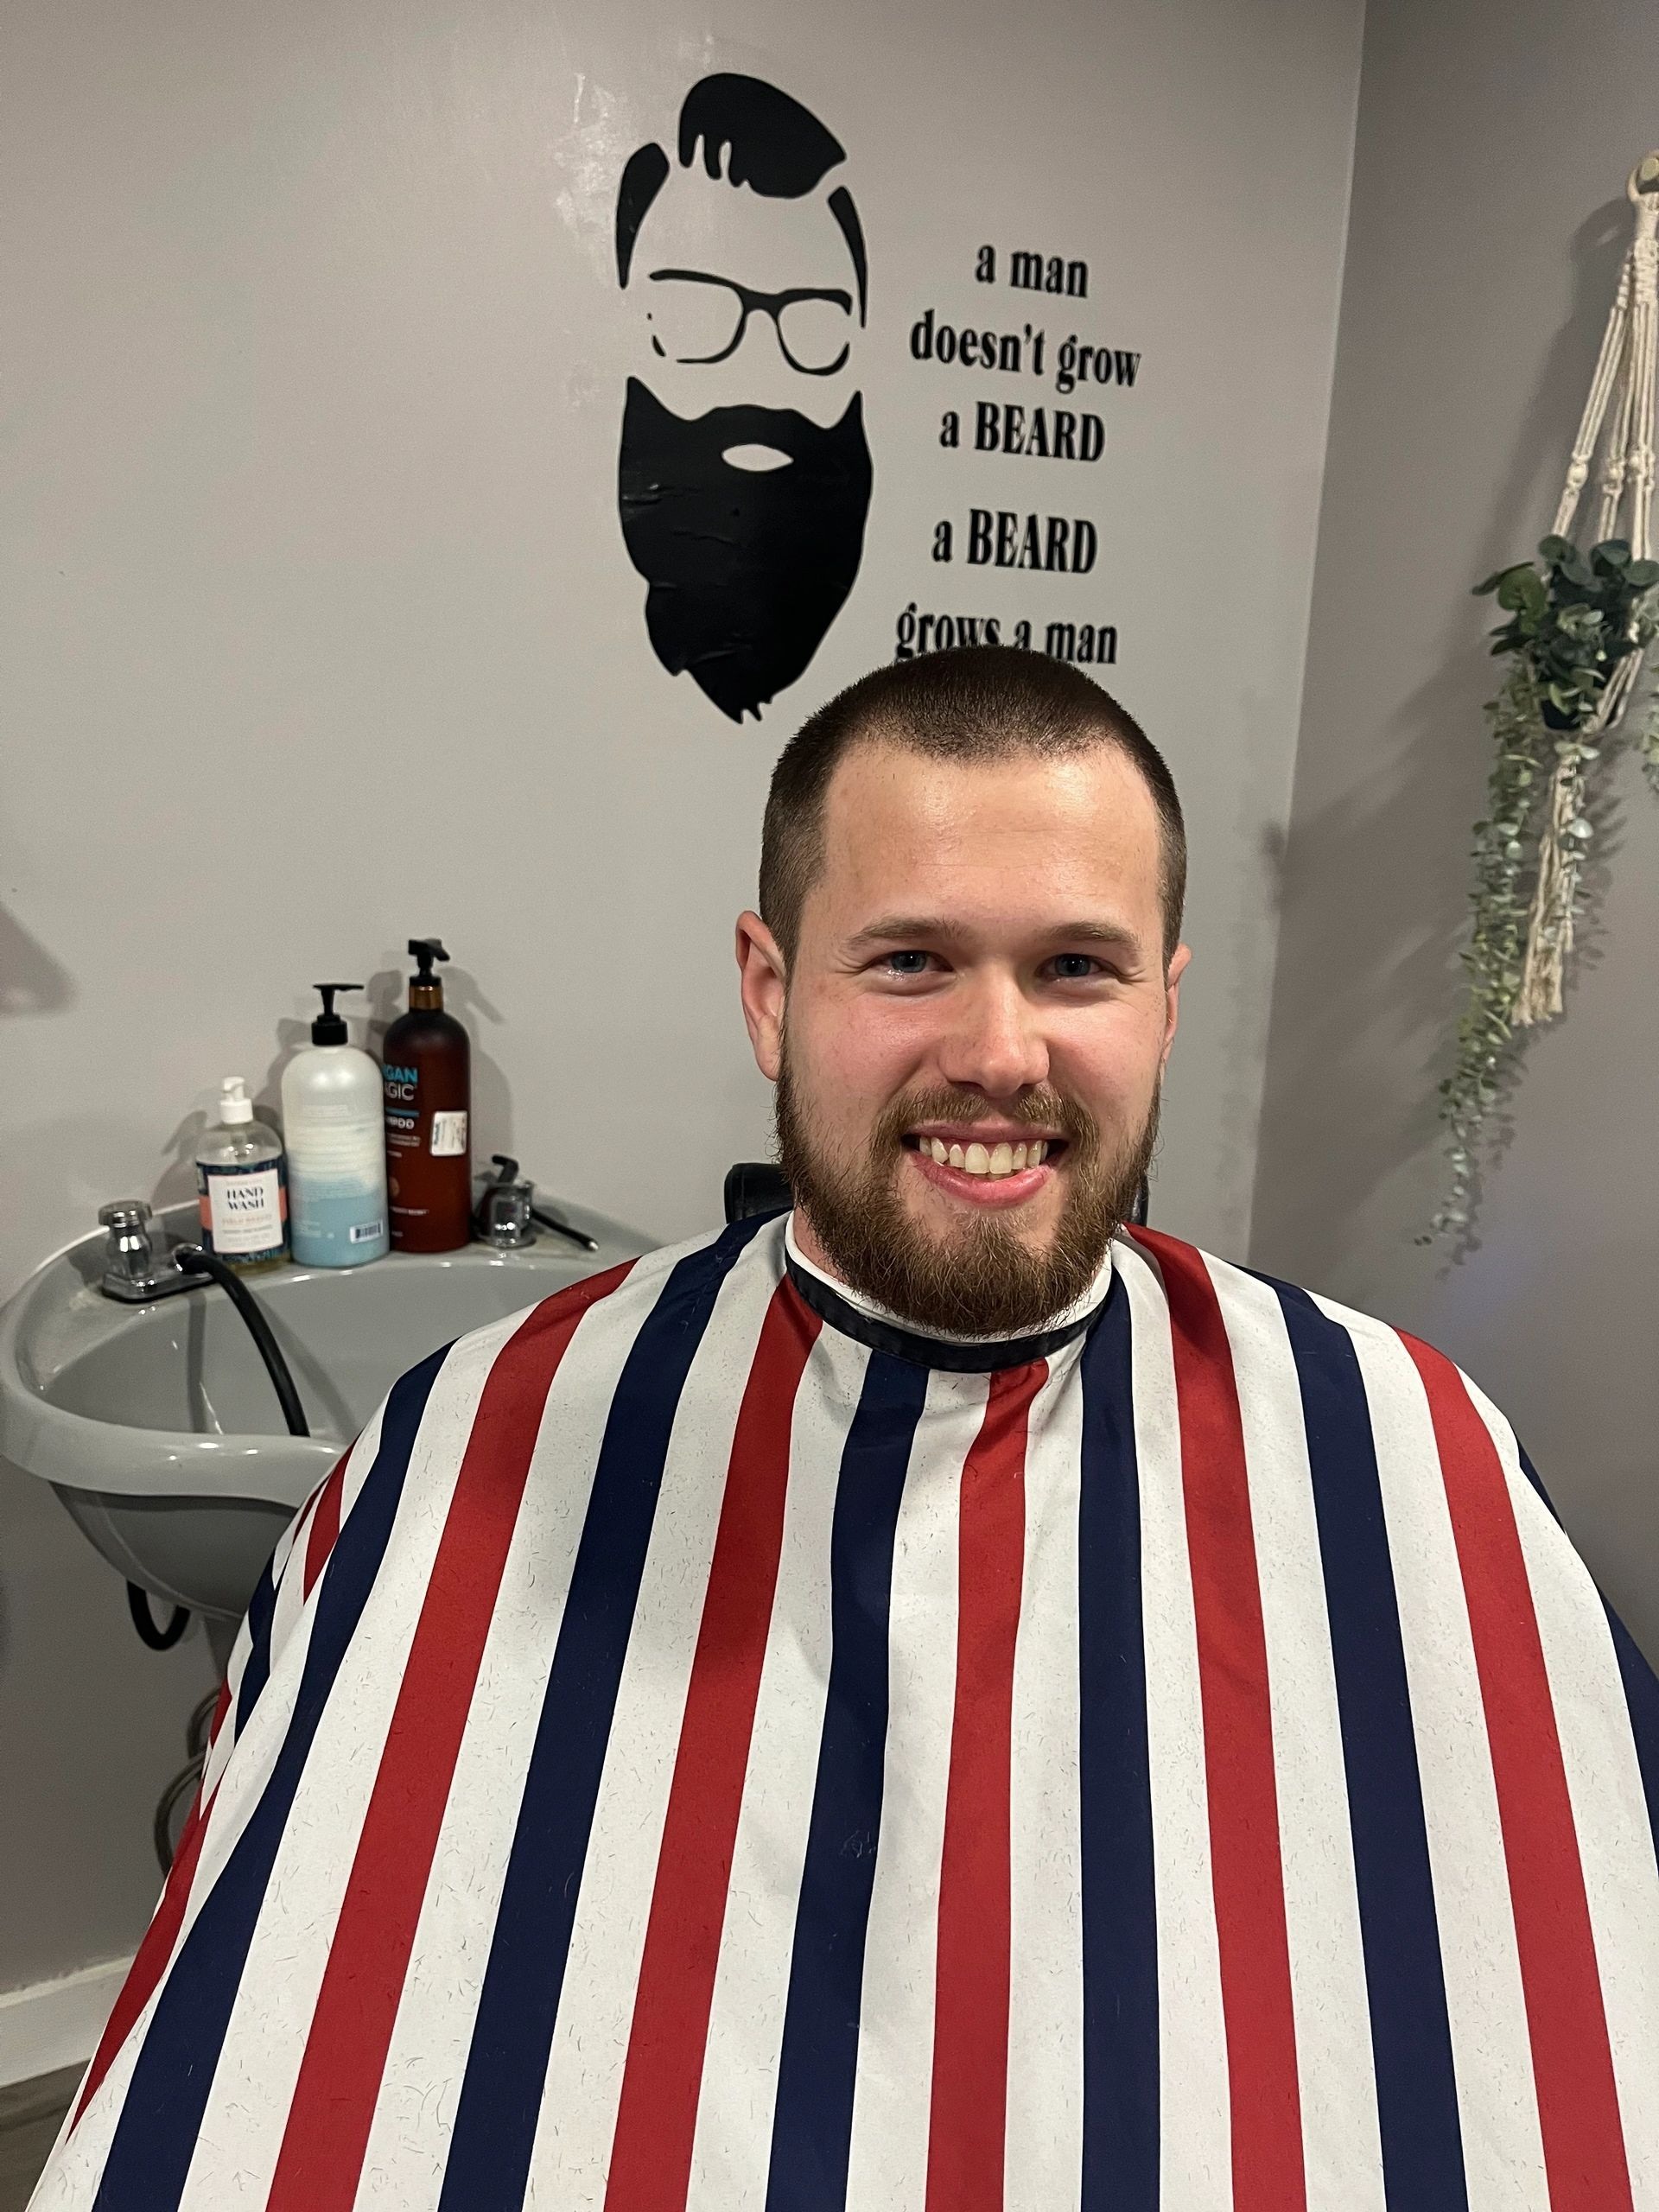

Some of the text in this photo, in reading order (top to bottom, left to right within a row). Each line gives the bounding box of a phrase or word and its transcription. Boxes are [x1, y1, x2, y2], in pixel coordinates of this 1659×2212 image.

[975, 245, 1088, 298] a man
[910, 308, 1141, 395] doesn't grow
[939, 401, 1105, 462] a BEARD
[932, 508, 1097, 575] a BEARD
[895, 602, 1117, 664] grows a man
[383, 1064, 418, 1084] GAN
[385, 1082, 415, 1101] GIC
[226, 1186, 264, 1199] HAND
[228, 1198, 264, 1211] WASH
